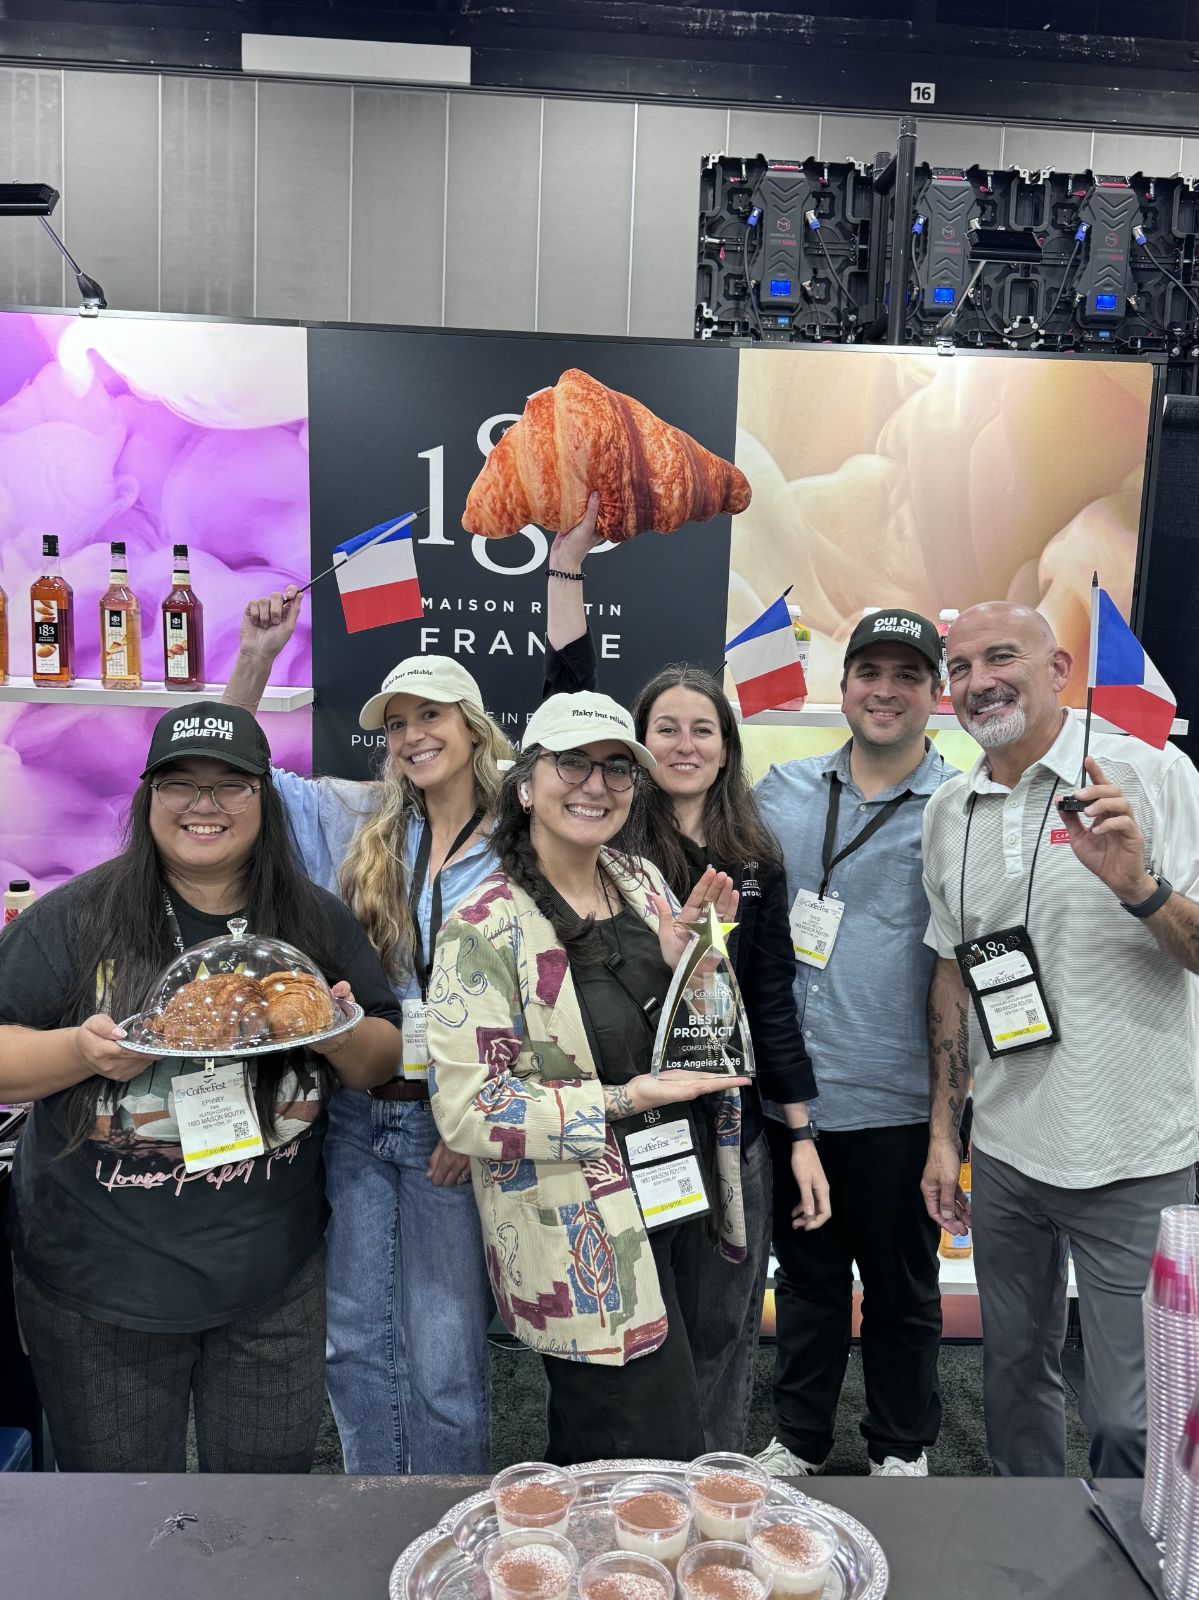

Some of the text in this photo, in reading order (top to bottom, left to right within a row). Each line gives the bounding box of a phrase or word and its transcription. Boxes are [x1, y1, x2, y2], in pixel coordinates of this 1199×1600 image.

[913, 86, 931, 101] 16
[421, 597, 621, 617] MAISON RTIN
[874, 617, 922, 632] OUI OUI
[872, 625, 921, 638] BAGUETTE
[420, 627, 621, 659] FRANE
[572, 709, 594, 718] Flaky
[594, 710, 608, 719] but
[173, 717, 234, 732] OUI OUI
[171, 728, 234, 741] BAGUETTE
[351, 735, 386, 747] PUR
[407, 1010, 428, 1019] CoffeeF
[688, 1014, 719, 1026] BEST
[673, 1026, 734, 1038] PRODUCT
[666, 1058, 741, 1070] Los Angeles 2026
